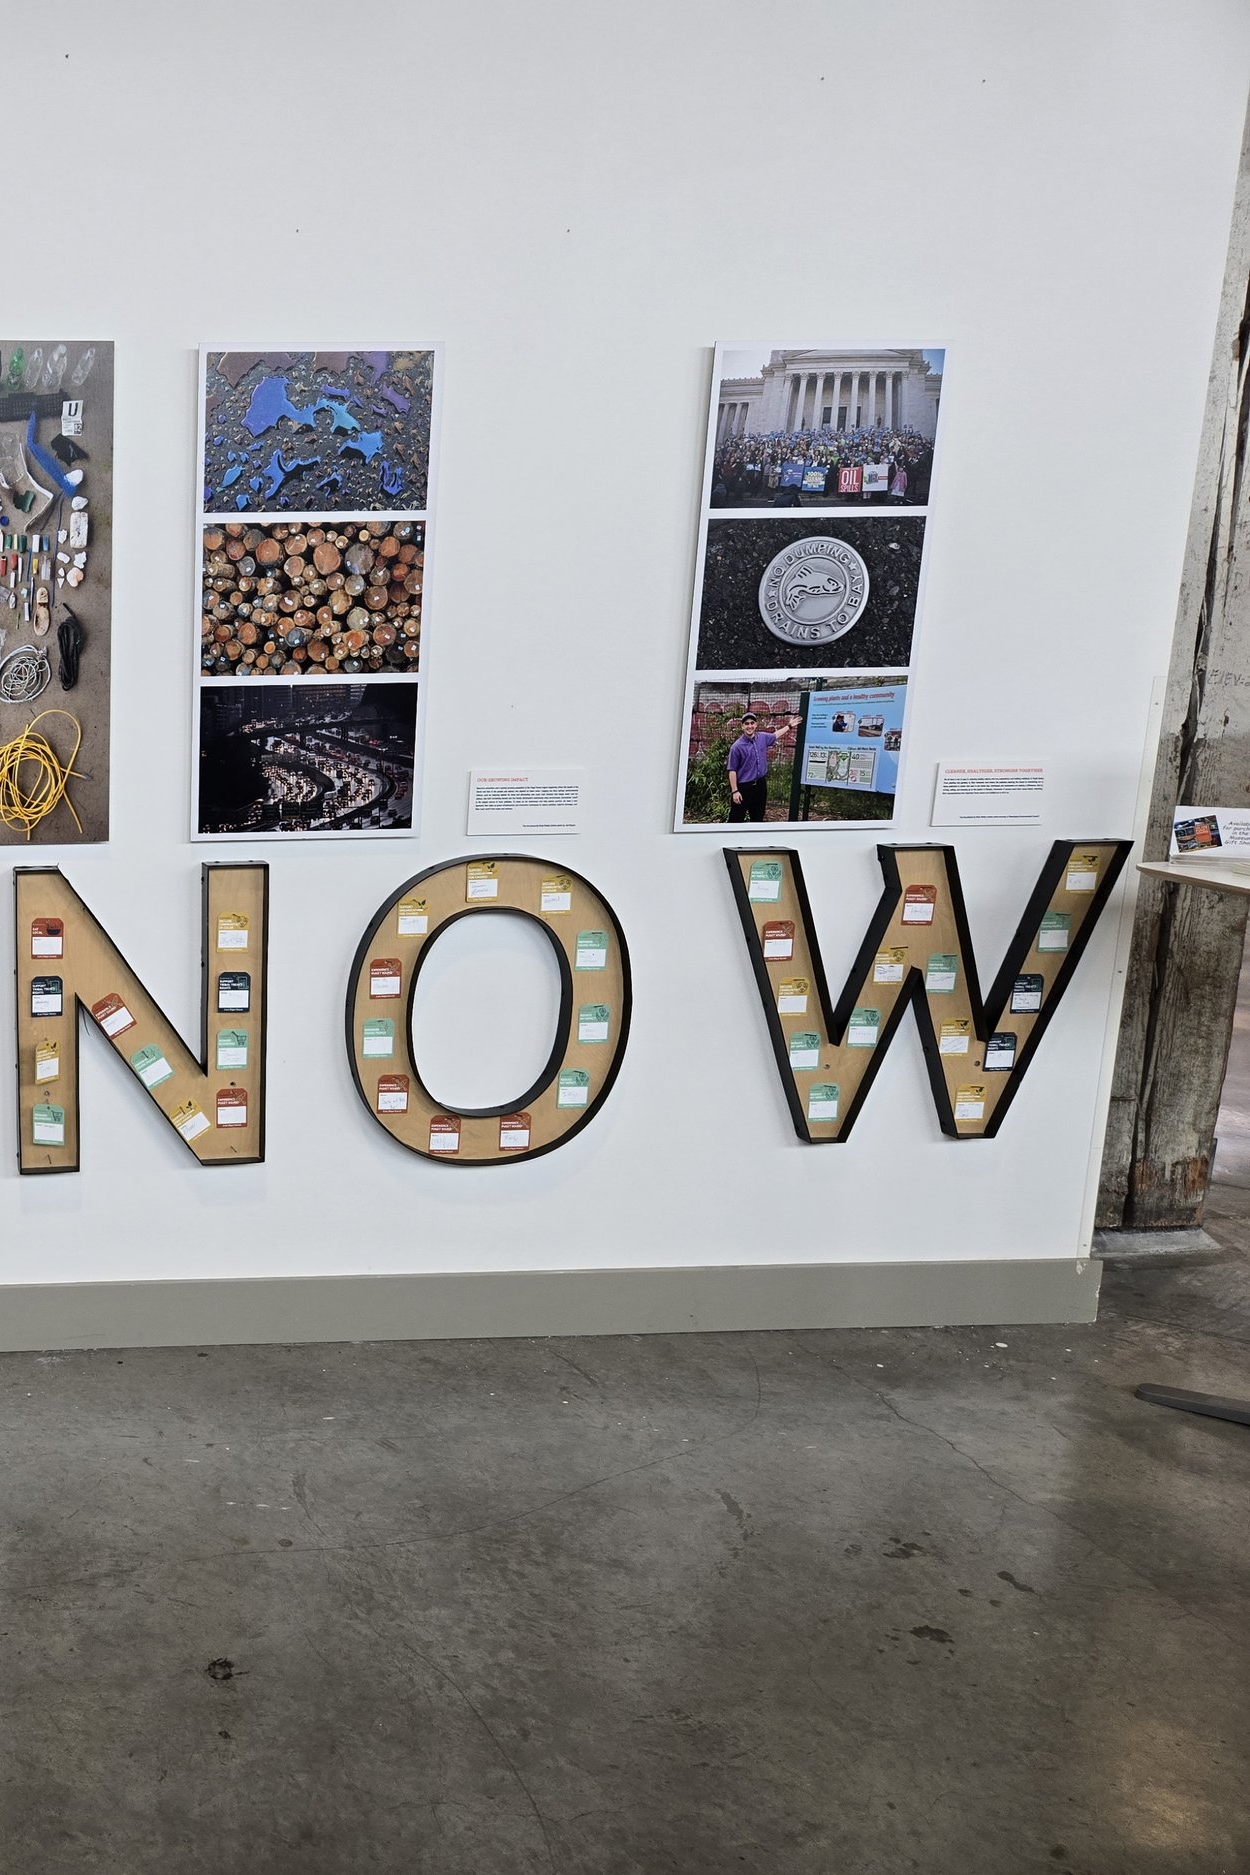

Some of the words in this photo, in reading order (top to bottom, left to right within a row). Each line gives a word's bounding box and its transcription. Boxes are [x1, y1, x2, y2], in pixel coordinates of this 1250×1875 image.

[68, 402, 78, 416] U
[842, 470, 859, 485] OIL
[768, 566, 785, 588] NO
[784, 543, 851, 565] DUMPING
[765, 601, 821, 640] DRAINS
[826, 612, 850, 632] TO
[848, 575, 864, 608] BAY
